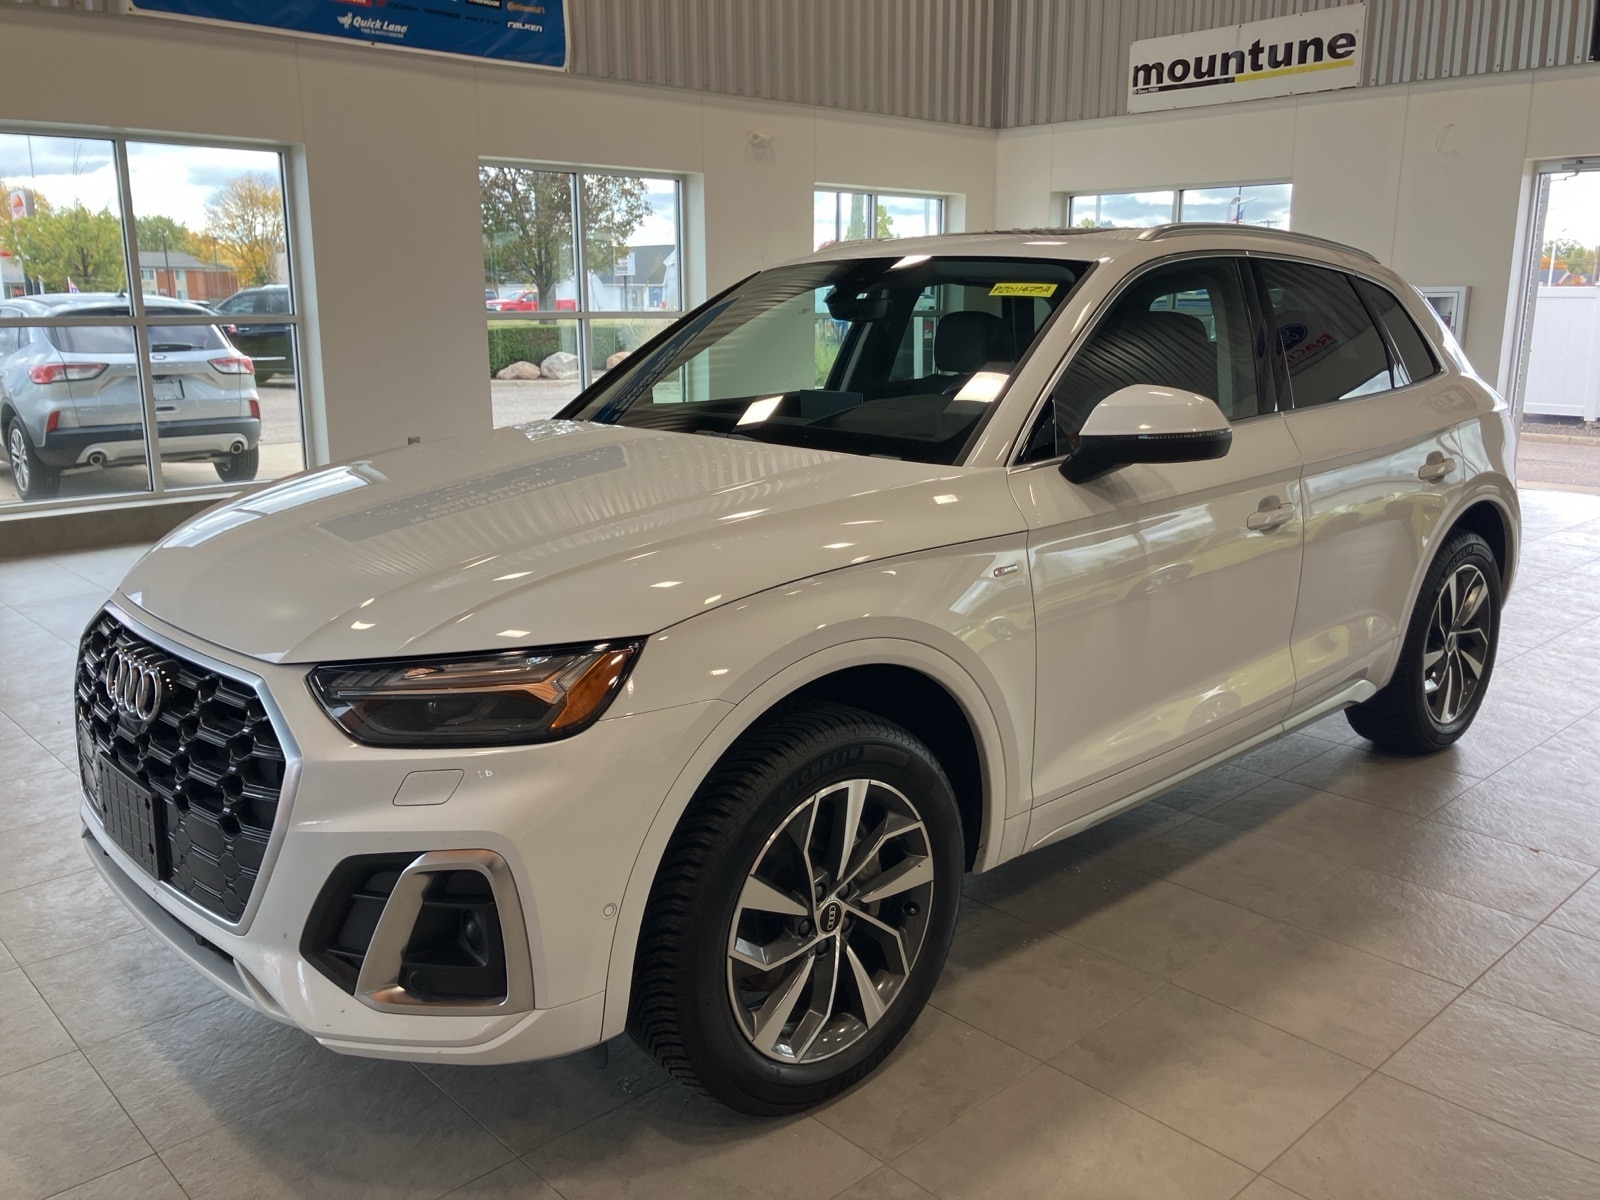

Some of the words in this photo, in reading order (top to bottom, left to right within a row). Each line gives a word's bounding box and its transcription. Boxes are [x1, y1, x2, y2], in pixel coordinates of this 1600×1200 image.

[353, 16, 382, 29] Quick
[382, 21, 408, 33] Lane
[507, 21, 543, 32] FALKEN
[1132, 32, 1356, 88] mountune
